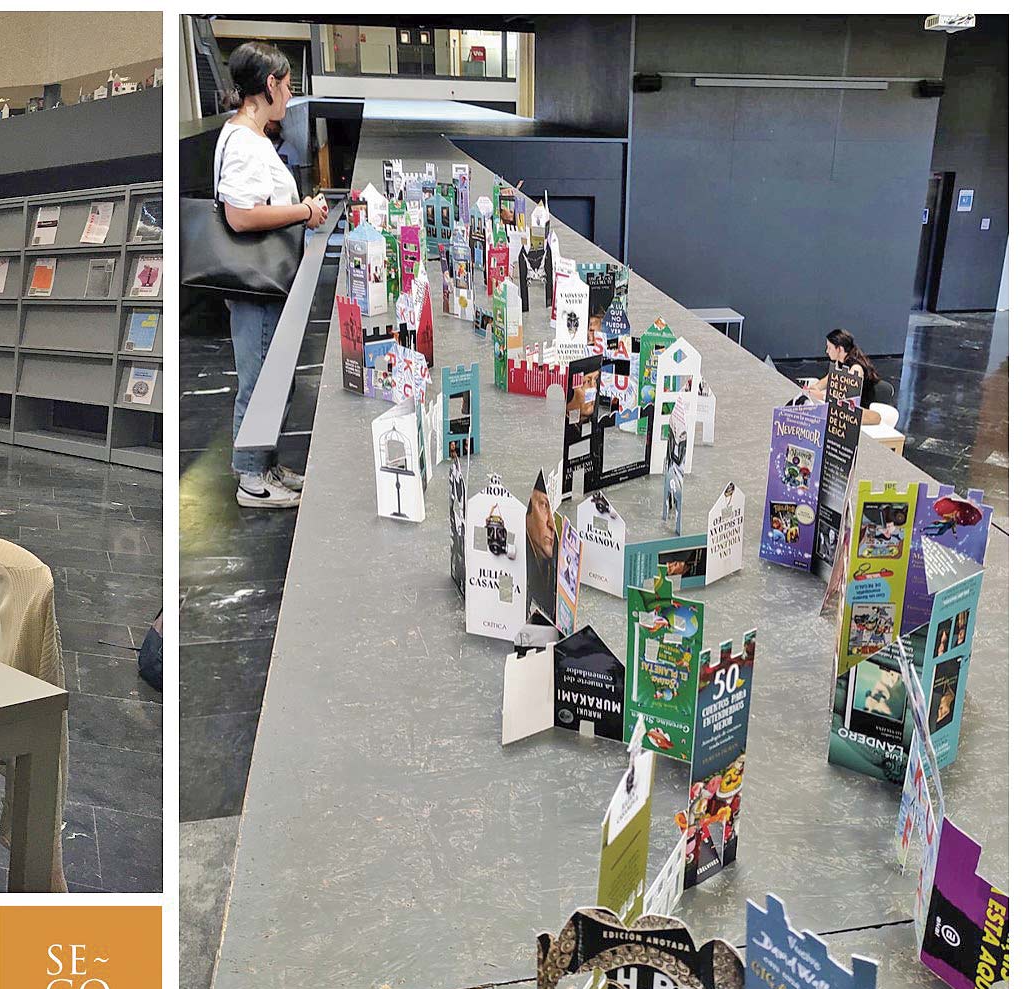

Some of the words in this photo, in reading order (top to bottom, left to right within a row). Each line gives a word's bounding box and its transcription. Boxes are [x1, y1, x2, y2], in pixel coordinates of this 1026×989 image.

[830, 373, 839, 381] LA
[840, 376, 859, 388] CHICA
[830, 381, 838, 389] DE
[839, 384, 847, 392] LA
[829, 417, 838, 426] DE
[838, 421, 847, 430] LA
[830, 408, 838, 417] LA
[839, 411, 858, 426] CHICA
[828, 426, 846, 439] LEICA
[579, 531, 620, 551] CASANOVA
[565, 667, 613, 681] comendador
[712, 663, 741, 701] 50
[576, 677, 604, 688] muerte
[605, 683, 615, 692] La
[557, 688, 621, 715] MURAKAMI
[701, 697, 730, 718] CUENTOS
[576, 706, 602, 720] HARUKI
[713, 715, 734, 733] MEJOR
[837, 727, 904, 757] LANDERO
[646, 934, 690, 953] ANOTADA
